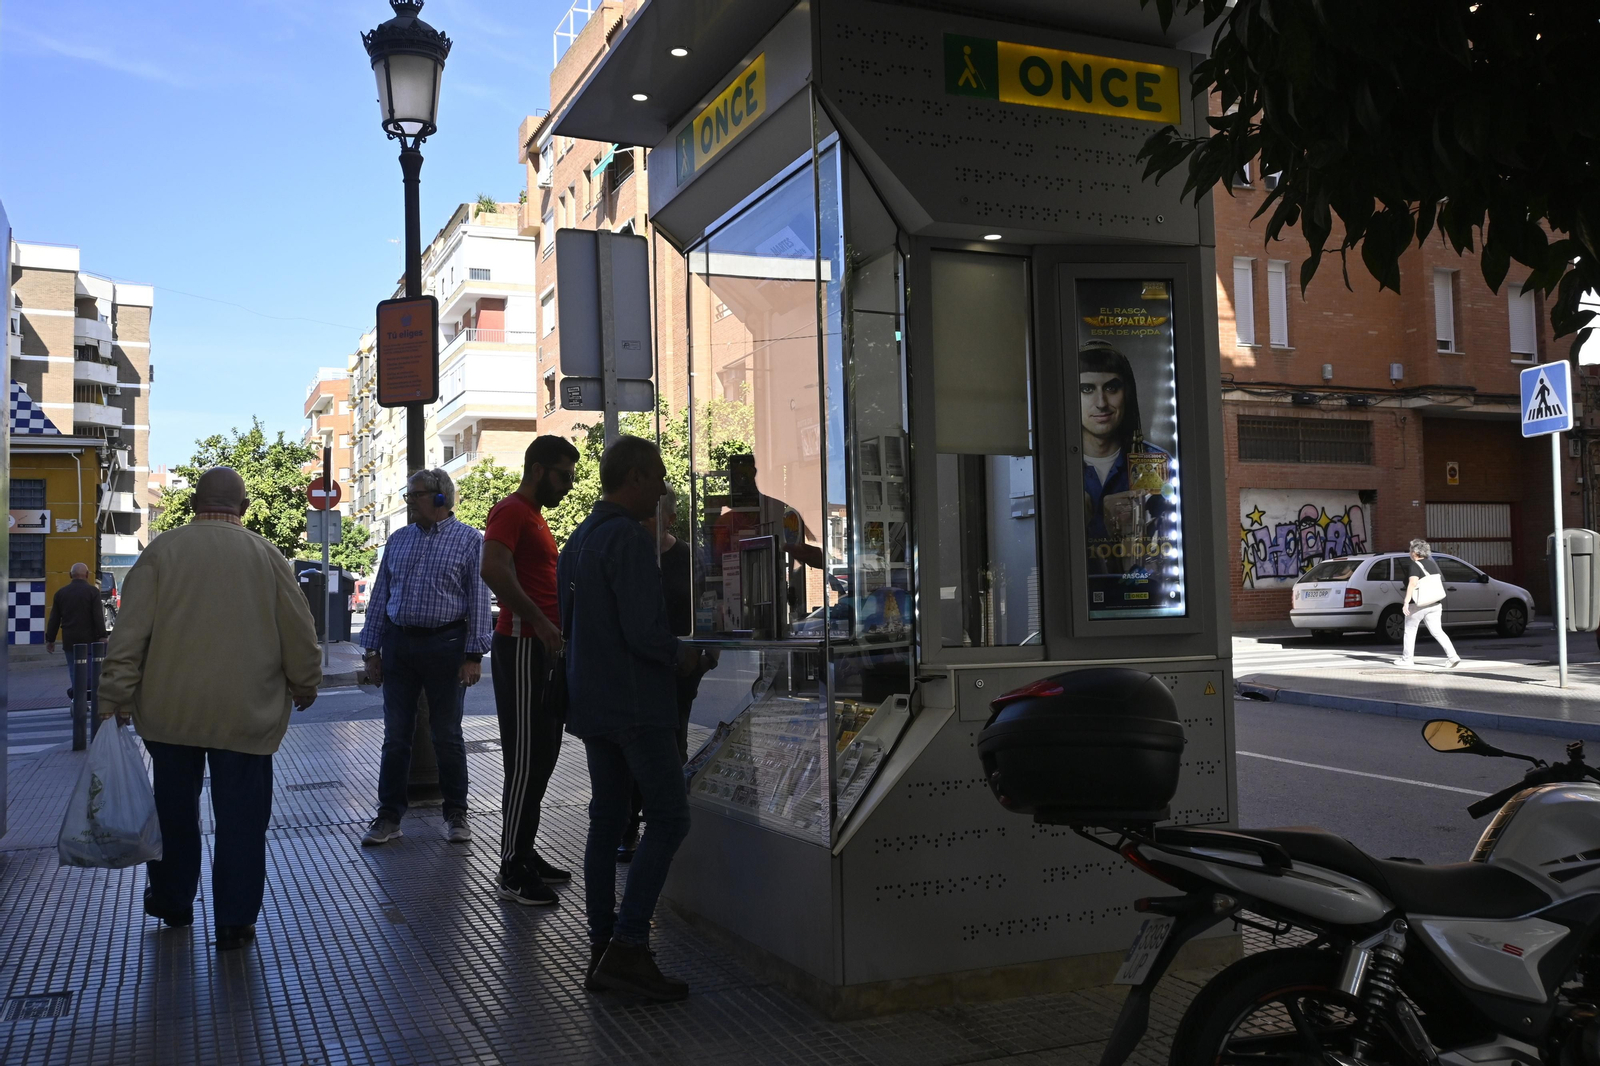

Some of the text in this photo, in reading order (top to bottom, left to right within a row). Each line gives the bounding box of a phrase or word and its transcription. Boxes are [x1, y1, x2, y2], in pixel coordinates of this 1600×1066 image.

[1019, 54, 1163, 114] ONCE
[700, 69, 759, 155] ONCE
[770, 237, 794, 257] MARTES
[1098, 315, 1154, 326] CLEOPATRA
[386, 329, 424, 340] Tú eliges
[1091, 327, 1115, 336] ESTÁ
[1122, 572, 1149, 580] RASCAS
